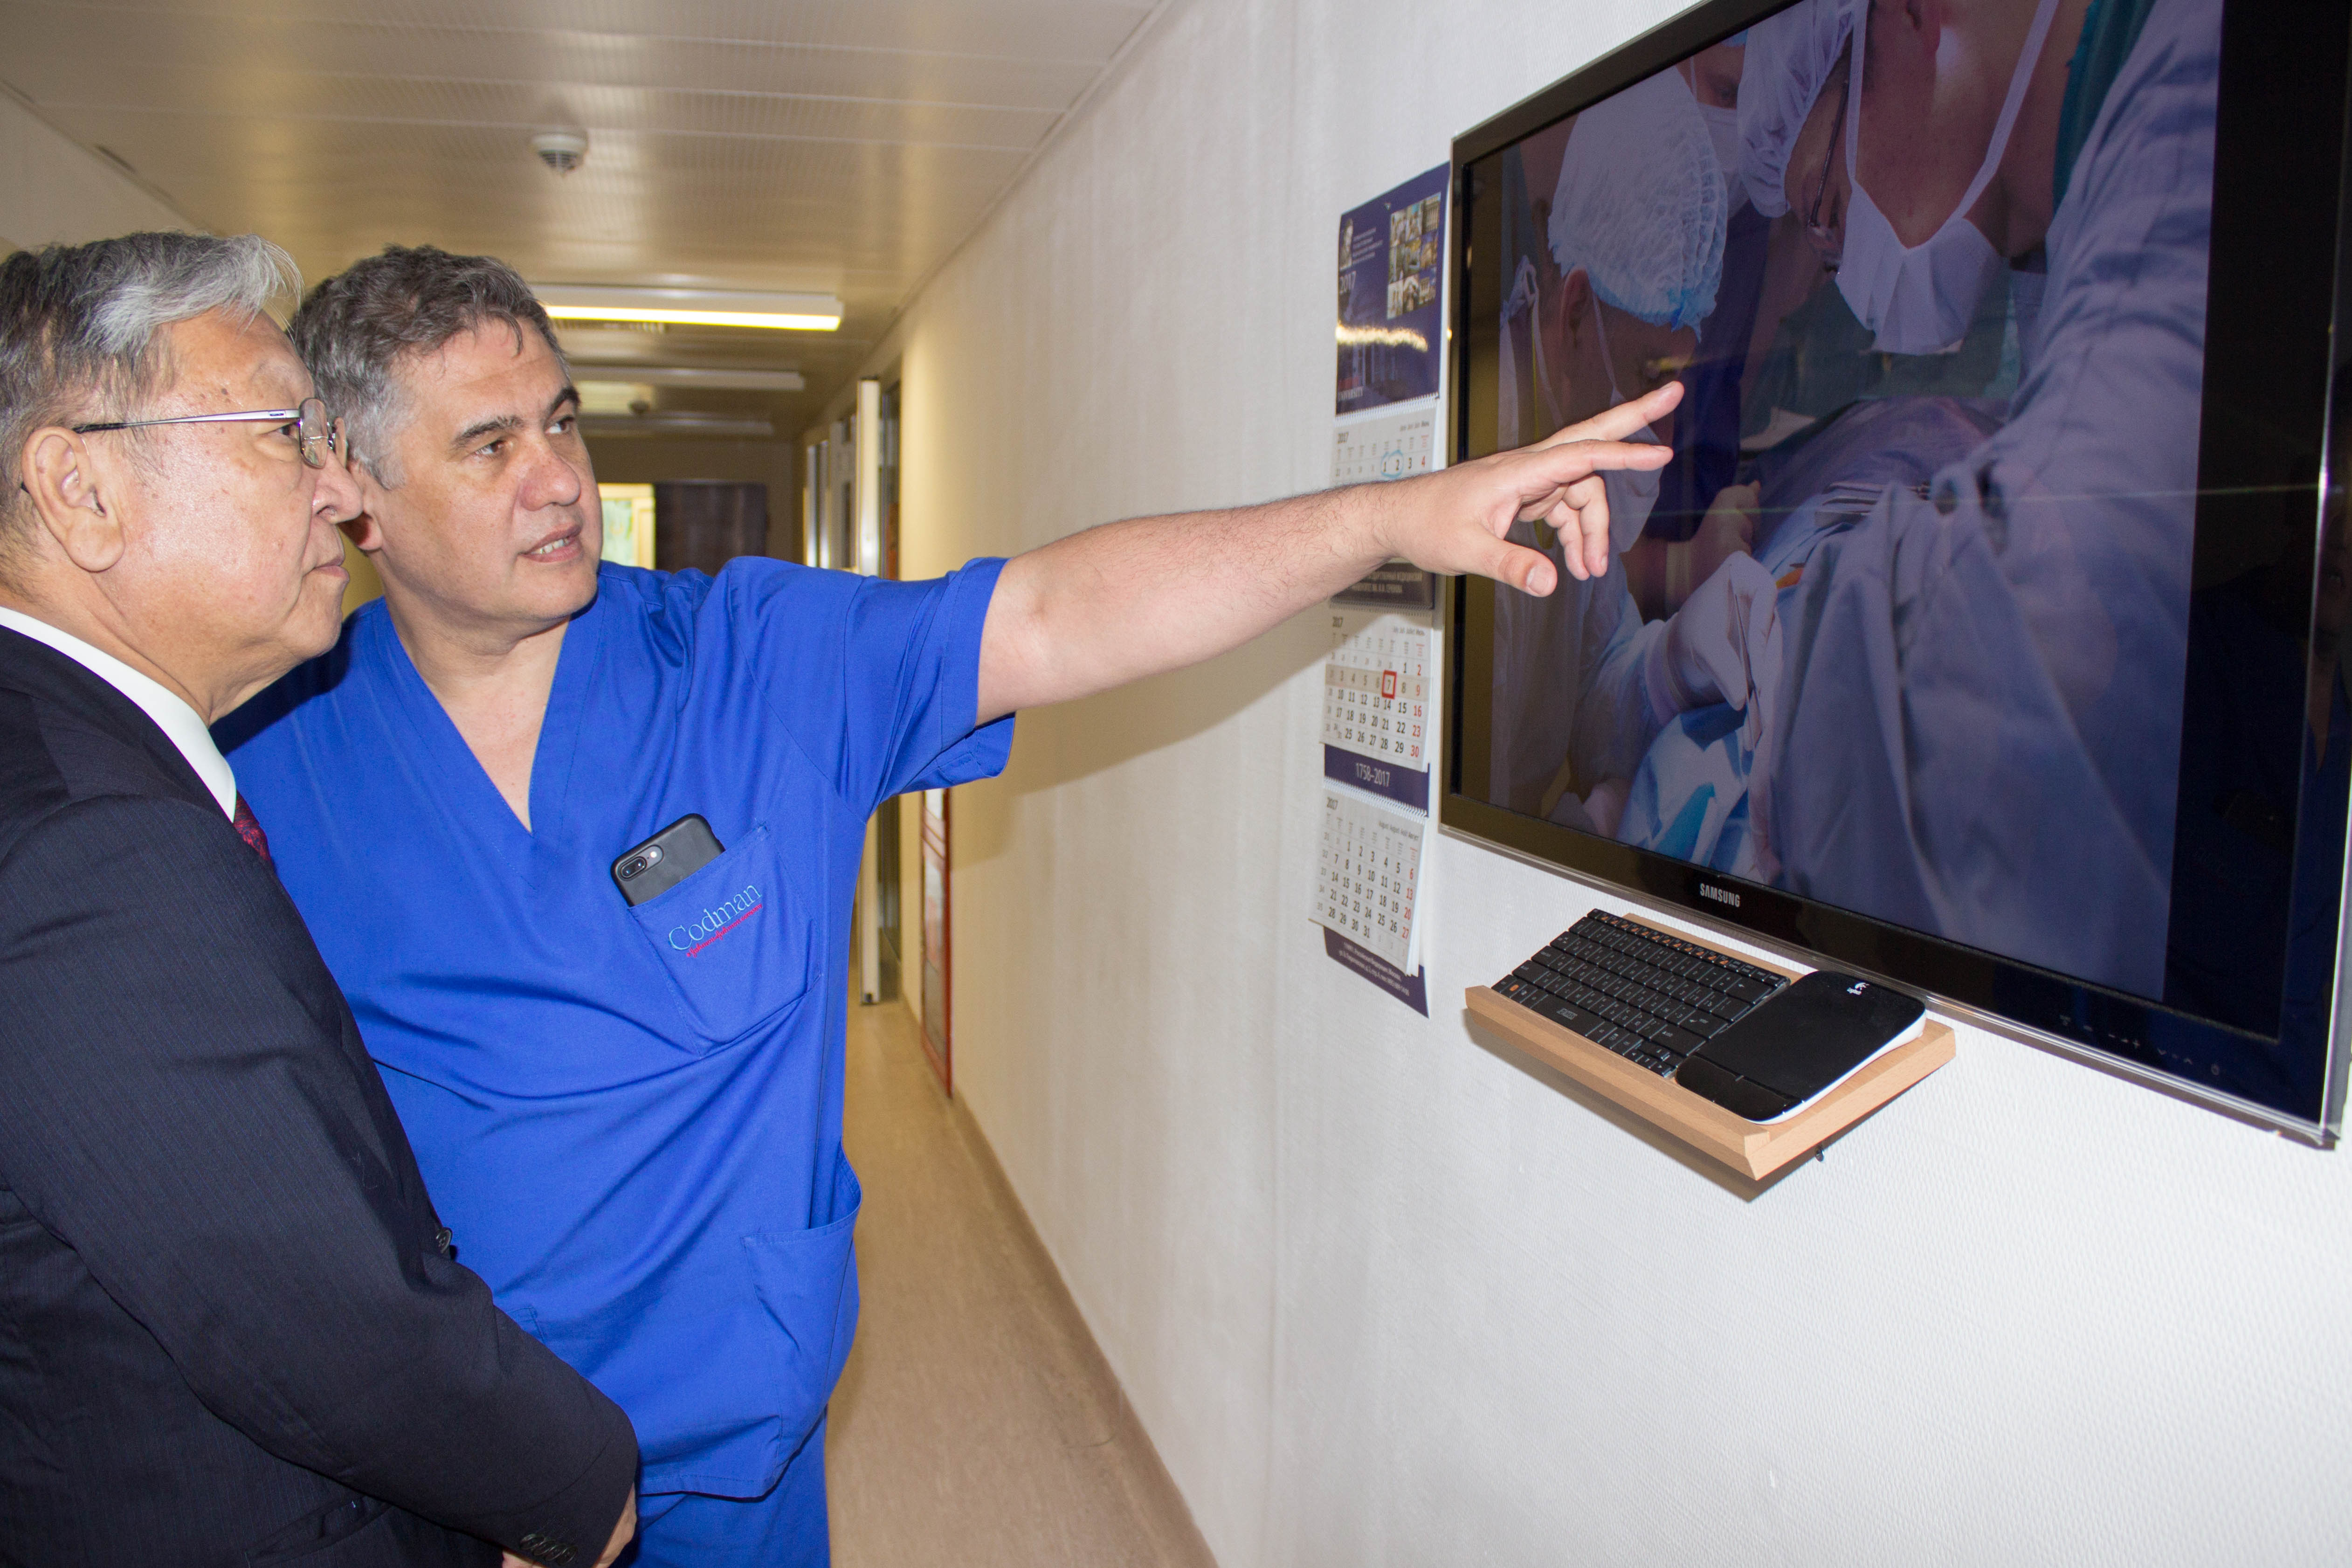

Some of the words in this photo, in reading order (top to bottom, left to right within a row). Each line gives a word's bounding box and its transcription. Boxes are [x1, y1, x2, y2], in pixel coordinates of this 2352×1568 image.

[1383, 461, 1386, 472] 1
[1395, 459, 1399, 471] 2
[1408, 457, 1412, 469] 3
[1421, 456, 1425, 468] 4
[1403, 662, 1407, 674] 1
[1417, 664, 1421, 676] 2
[1387, 679, 1391, 691] 7
[1401, 682, 1406, 694] 8
[1416, 684, 1420, 697] 9
[1338, 689, 1344, 700] 10
[1349, 691, 1355, 703] 11
[1361, 693, 1367, 705] 12
[1373, 696, 1379, 708] 13
[1384, 699, 1391, 711] 14
[1399, 702, 1407, 714] 15
[1414, 705, 1421, 718] 16
[1336, 707, 1342, 718] 17
[1347, 710, 1354, 721] 18
[1359, 713, 1366, 724] 19
[1371, 715, 1378, 727] 20
[1382, 718, 1389, 731] 21
[1397, 721, 1405, 734] 22
[1413, 725, 1421, 737] 23
[1345, 728, 1352, 739] 25
[1358, 731, 1365, 743] 26
[1369, 734, 1376, 746] 27
[1380, 738, 1388, 750] 28
[1395, 741, 1404, 753] 29
[1411, 745, 1419, 758] 30
[1356, 762, 1390, 787] 1758-2017
[1327, 796, 1338, 810] 2017
[1347, 841, 1351, 852] 1
[1359, 845, 1363, 857] 2
[1371, 850, 1375, 862] 3
[1384, 857, 1388, 868] 4
[1396, 862, 1400, 874] 5
[1410, 868, 1414, 880] 6
[1335, 853, 1338, 864] 7
[1345, 859, 1349, 870] 8
[1358, 864, 1361, 876] 9
[1368, 869, 1375, 882] 10
[1381, 875, 1388, 888] 11
[1393, 881, 1400, 895] 12
[1406, 887, 1414, 901] 13
[1331, 871, 1338, 883] 14
[1343, 877, 1350, 889] 15
[1355, 882, 1361, 895] 16
[1366, 888, 1373, 900] 17
[1379, 894, 1386, 907] 18
[1392, 900, 1399, 913] 19
[1404, 907, 1411, 921] 20
[1700, 883, 1740, 908] SAMSUNG
[669, 885, 762, 950] Codman
[1329, 906, 1335, 919] 28
[1340, 912, 1346, 925] 29
[1352, 919, 1359, 932] 30
[1363, 925, 1370, 939] 31
[1330, 889, 1337, 901] 21
[1341, 894, 1348, 907] 22
[1353, 900, 1360, 913] 23
[1365, 906, 1372, 920] 24
[1378, 912, 1385, 926] 25
[1390, 919, 1397, 933] 26
[1402, 926, 1409, 940] 27
